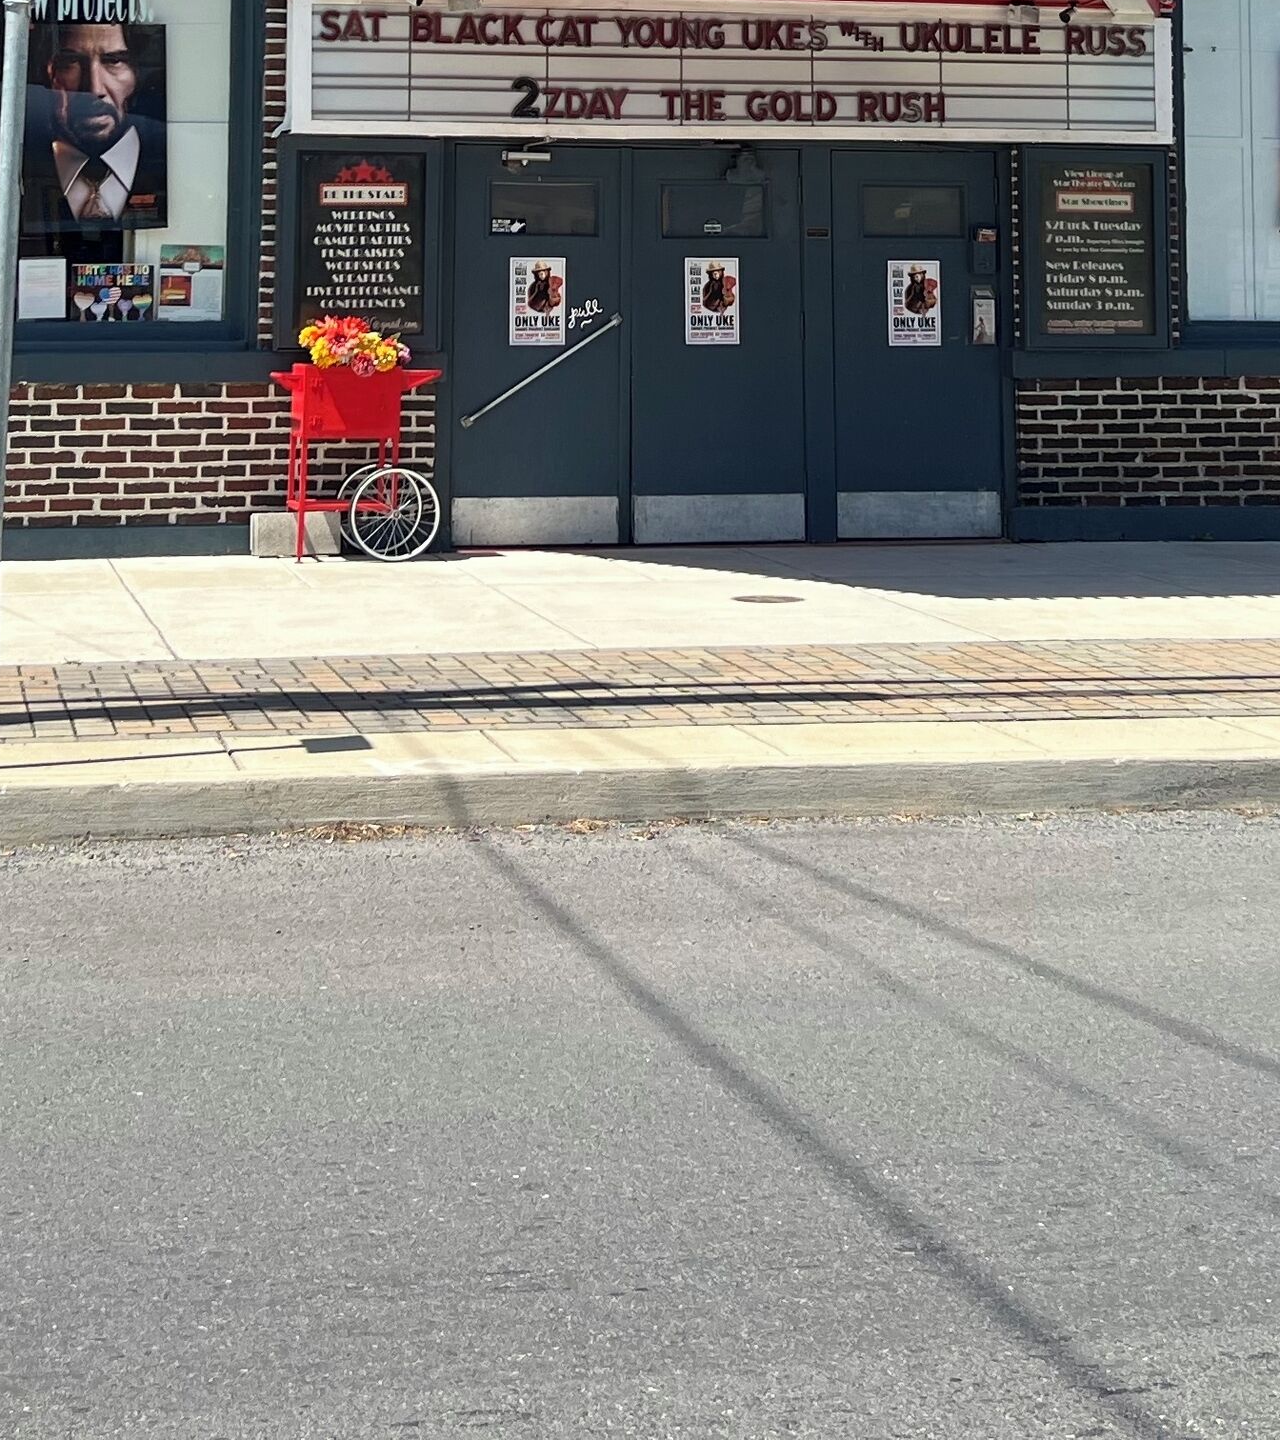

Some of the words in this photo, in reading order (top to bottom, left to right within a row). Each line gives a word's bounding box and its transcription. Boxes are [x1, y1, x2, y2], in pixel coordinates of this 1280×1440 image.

[319, 10, 388, 42] SAT
[411, 11, 526, 46] BLACK
[536, 16, 599, 47] CAT
[615, 16, 726, 49] YOUNG
[741, 19, 829, 52] UKES
[838, 21, 884, 53] WITH
[899, 22, 1041, 55] UKULELE
[1065, 24, 1147, 57] RUSS
[511, 76, 630, 119] 2ZDAY
[659, 89, 727, 121] THE
[745, 90, 838, 122] GOLD
[857, 91, 946, 123] RUSH
[1093, 220, 1144, 232] Tuesday
[77, 265, 106, 275] HATE
[134, 265, 150, 275] NO
[1045, 261, 1070, 270] New
[1073, 261, 1124, 271] Releases
[77, 275, 114, 286] HOME
[117, 275, 150, 286] HERE
[1045, 274, 1086, 284] Friday
[1046, 287, 1102, 298] Saturday
[1046, 300, 1092, 311] Sunday
[568, 299, 603, 329] pull
[515, 315, 539, 327] ONLY
[541, 315, 560, 326] UKE
[690, 315, 713, 326] ONLY
[716, 315, 734, 326] UKE
[893, 317, 915, 328] ONLY
[918, 317, 936, 328] UKE
